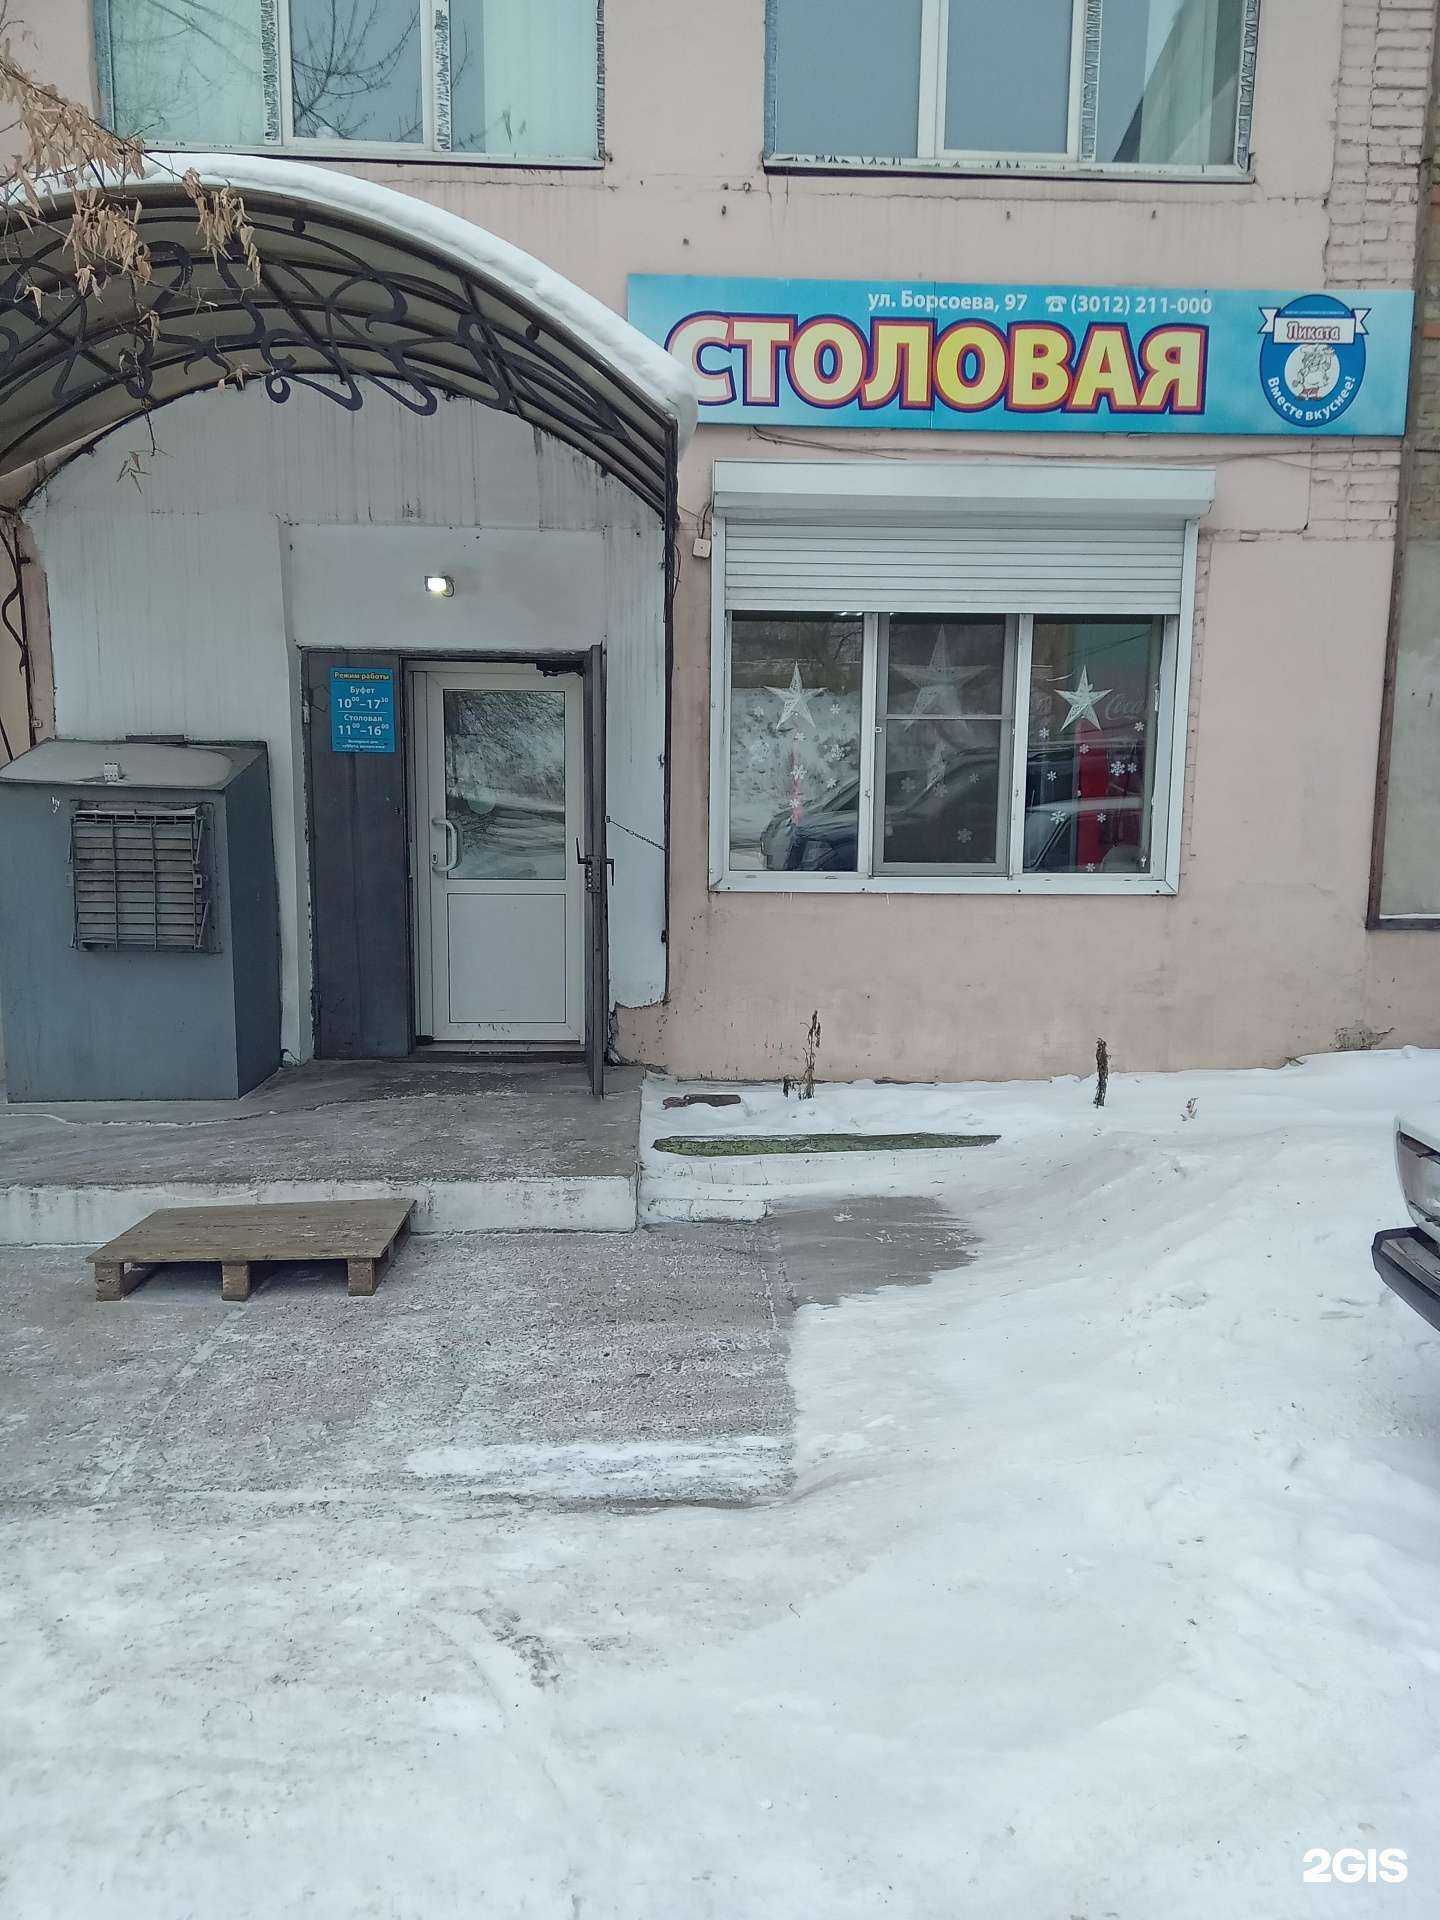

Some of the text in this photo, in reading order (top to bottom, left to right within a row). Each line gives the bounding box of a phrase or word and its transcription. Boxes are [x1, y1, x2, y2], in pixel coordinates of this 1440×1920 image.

[868, 290, 1028, 312] ул. Борсоева, 97
[1071, 295, 1213, 315] (3012) 211-000
[1287, 320, 1340, 340] Пиката
[665, 311, 1208, 415] СТОЛОВАЯ
[1268, 375, 1356, 421] Вместе вкуснее!
